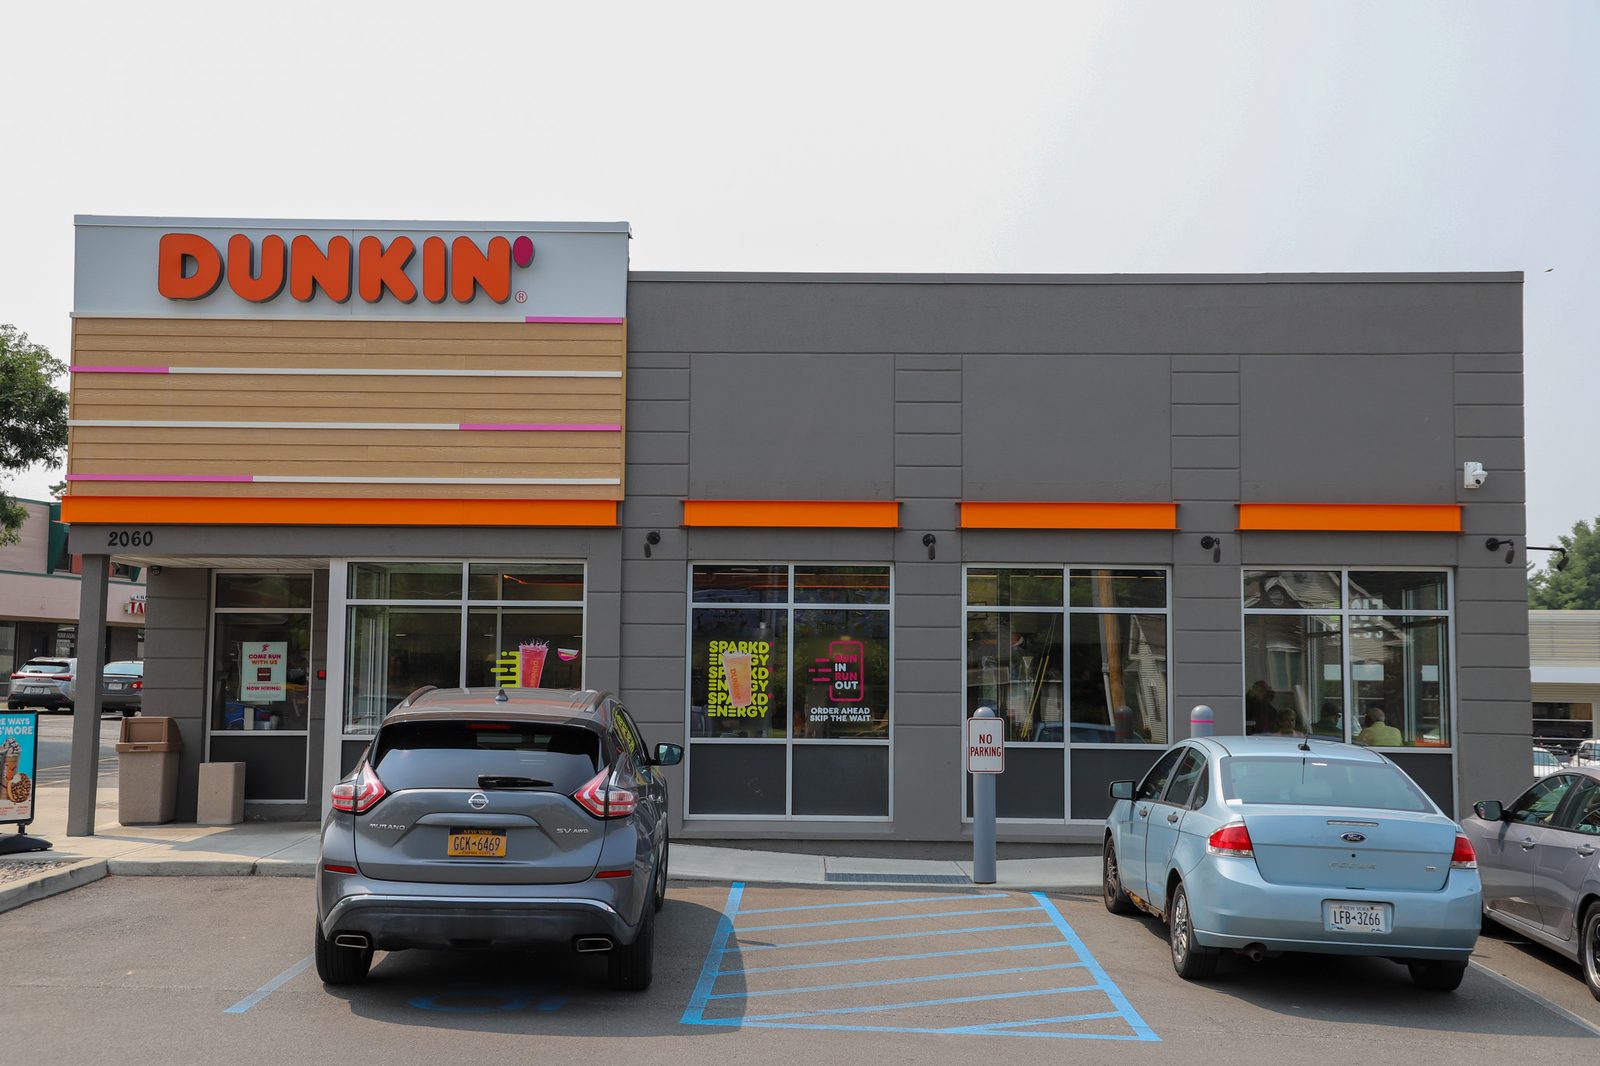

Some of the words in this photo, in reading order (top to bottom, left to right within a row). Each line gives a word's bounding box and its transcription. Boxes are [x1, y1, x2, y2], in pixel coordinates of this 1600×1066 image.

[158, 233, 534, 304] DUNKIN'
[108, 531, 153, 547] 2060
[834, 663, 846, 672] IN
[835, 672, 857, 680] RUN
[834, 681, 859, 689] OUT
[707, 704, 768, 718] ENERGY
[810, 707, 839, 715] ORDER
[841, 707, 871, 715] AHEAD
[979, 734, 993, 744] NO
[970, 746, 1002, 757] PARKING
[1346, 833, 1361, 842] Ford
[453, 837, 471, 851] GCK
[477, 838, 501, 851] 6469
[1333, 910, 1351, 925] LFB
[1357, 912, 1381, 926] 3266
